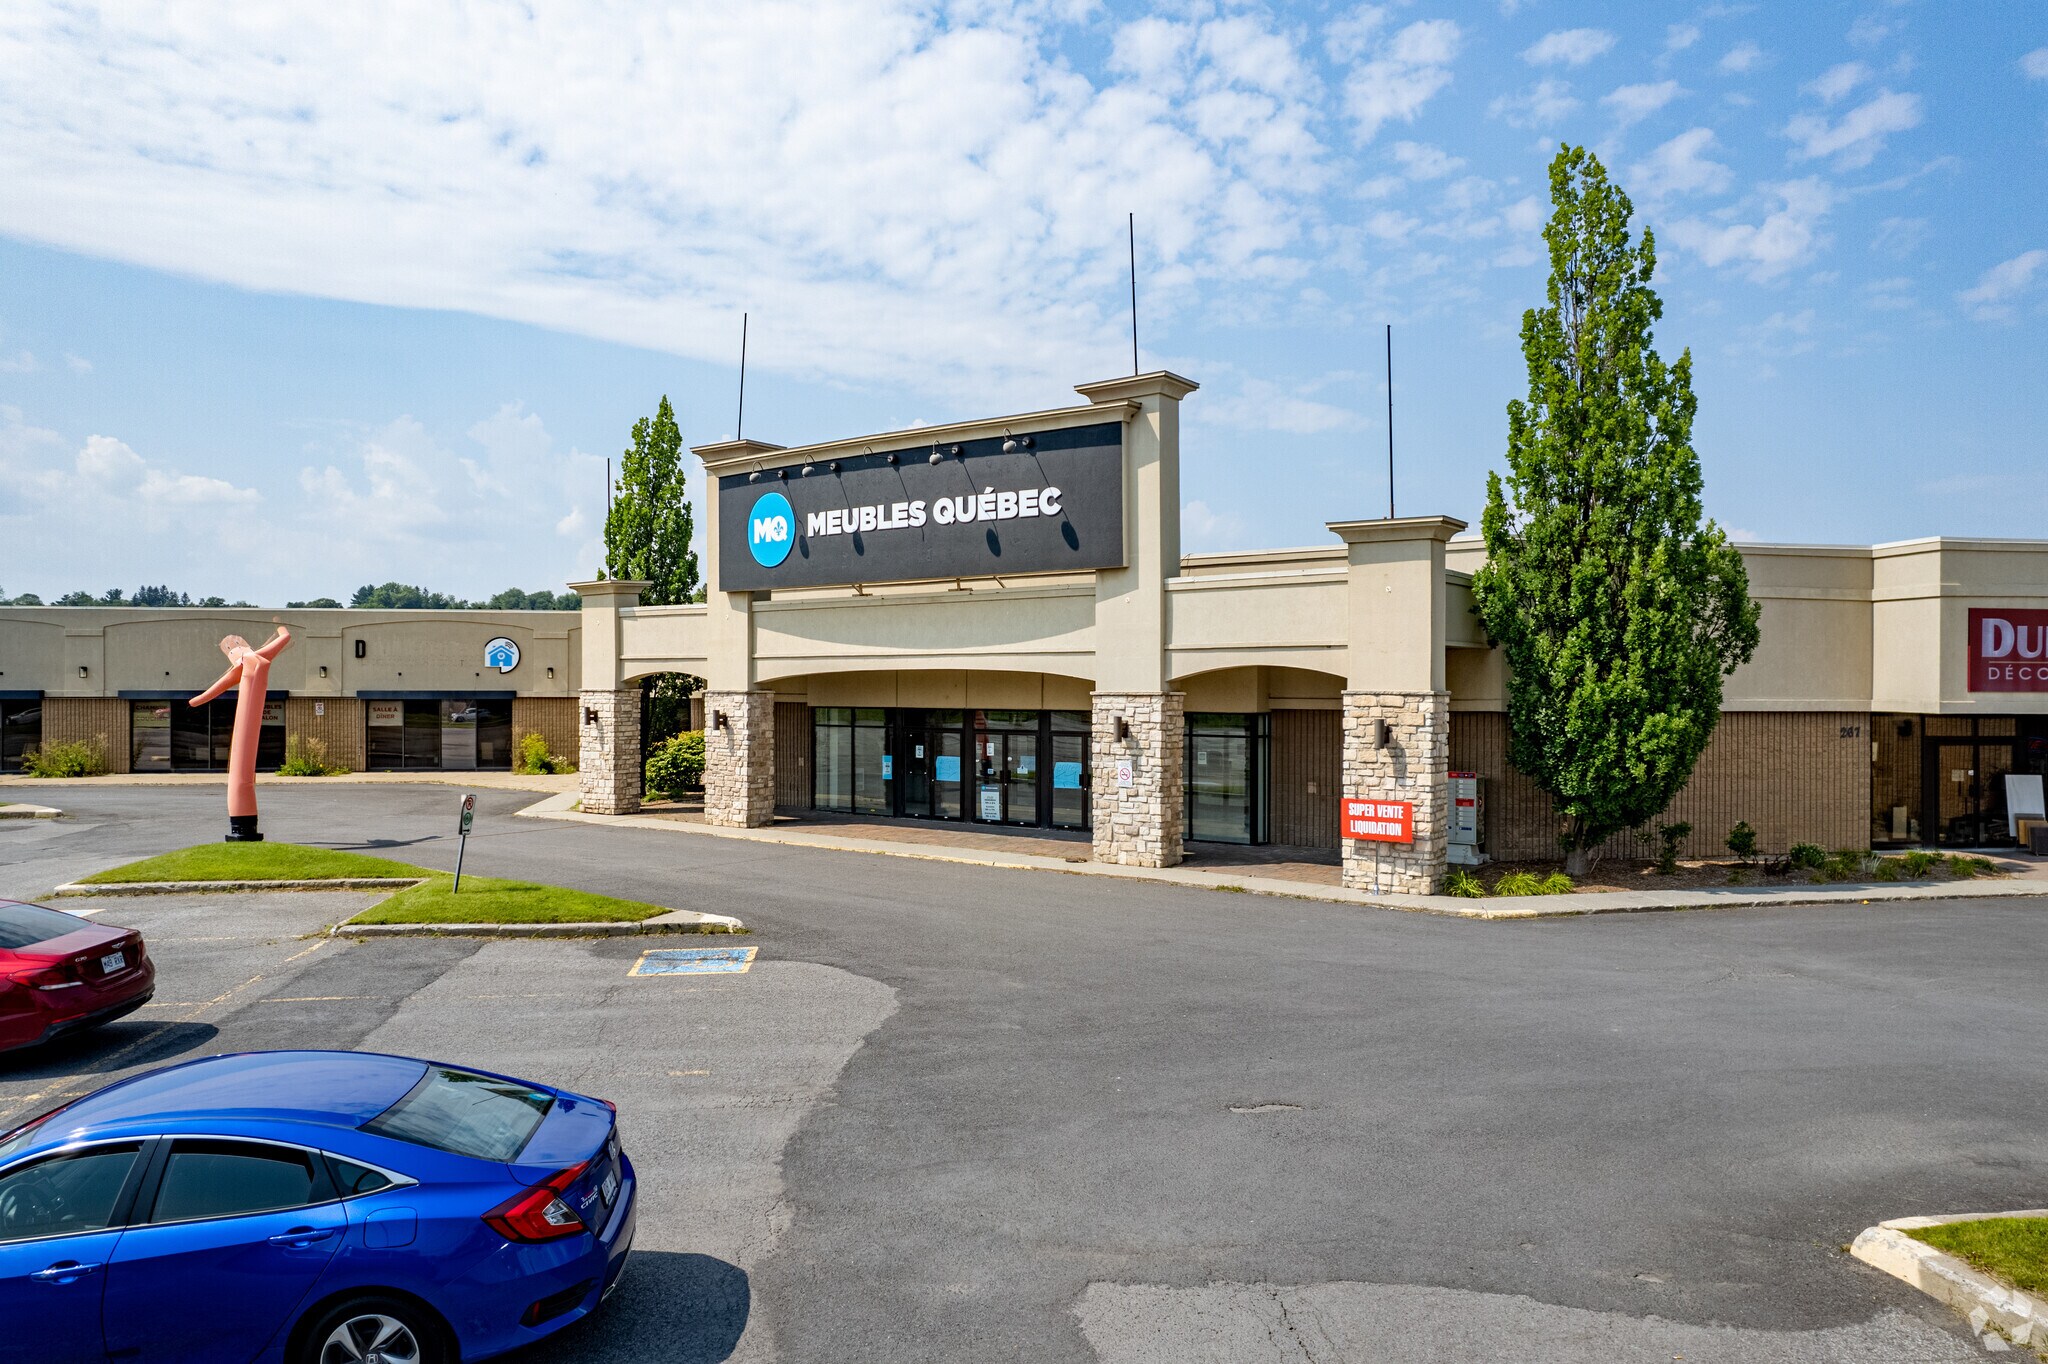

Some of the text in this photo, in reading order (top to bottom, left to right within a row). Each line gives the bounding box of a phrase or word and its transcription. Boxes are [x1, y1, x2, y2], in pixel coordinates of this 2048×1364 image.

[807, 486, 1062, 537] MEUBLES QUÉBEC
[753, 515, 788, 544] MQ
[355, 639, 366, 658] D
[1982, 617, 2048, 659] DU
[1349, 802, 1404, 819] SUPER VENTE
[1350, 819, 1402, 837] LIQUIDATION
